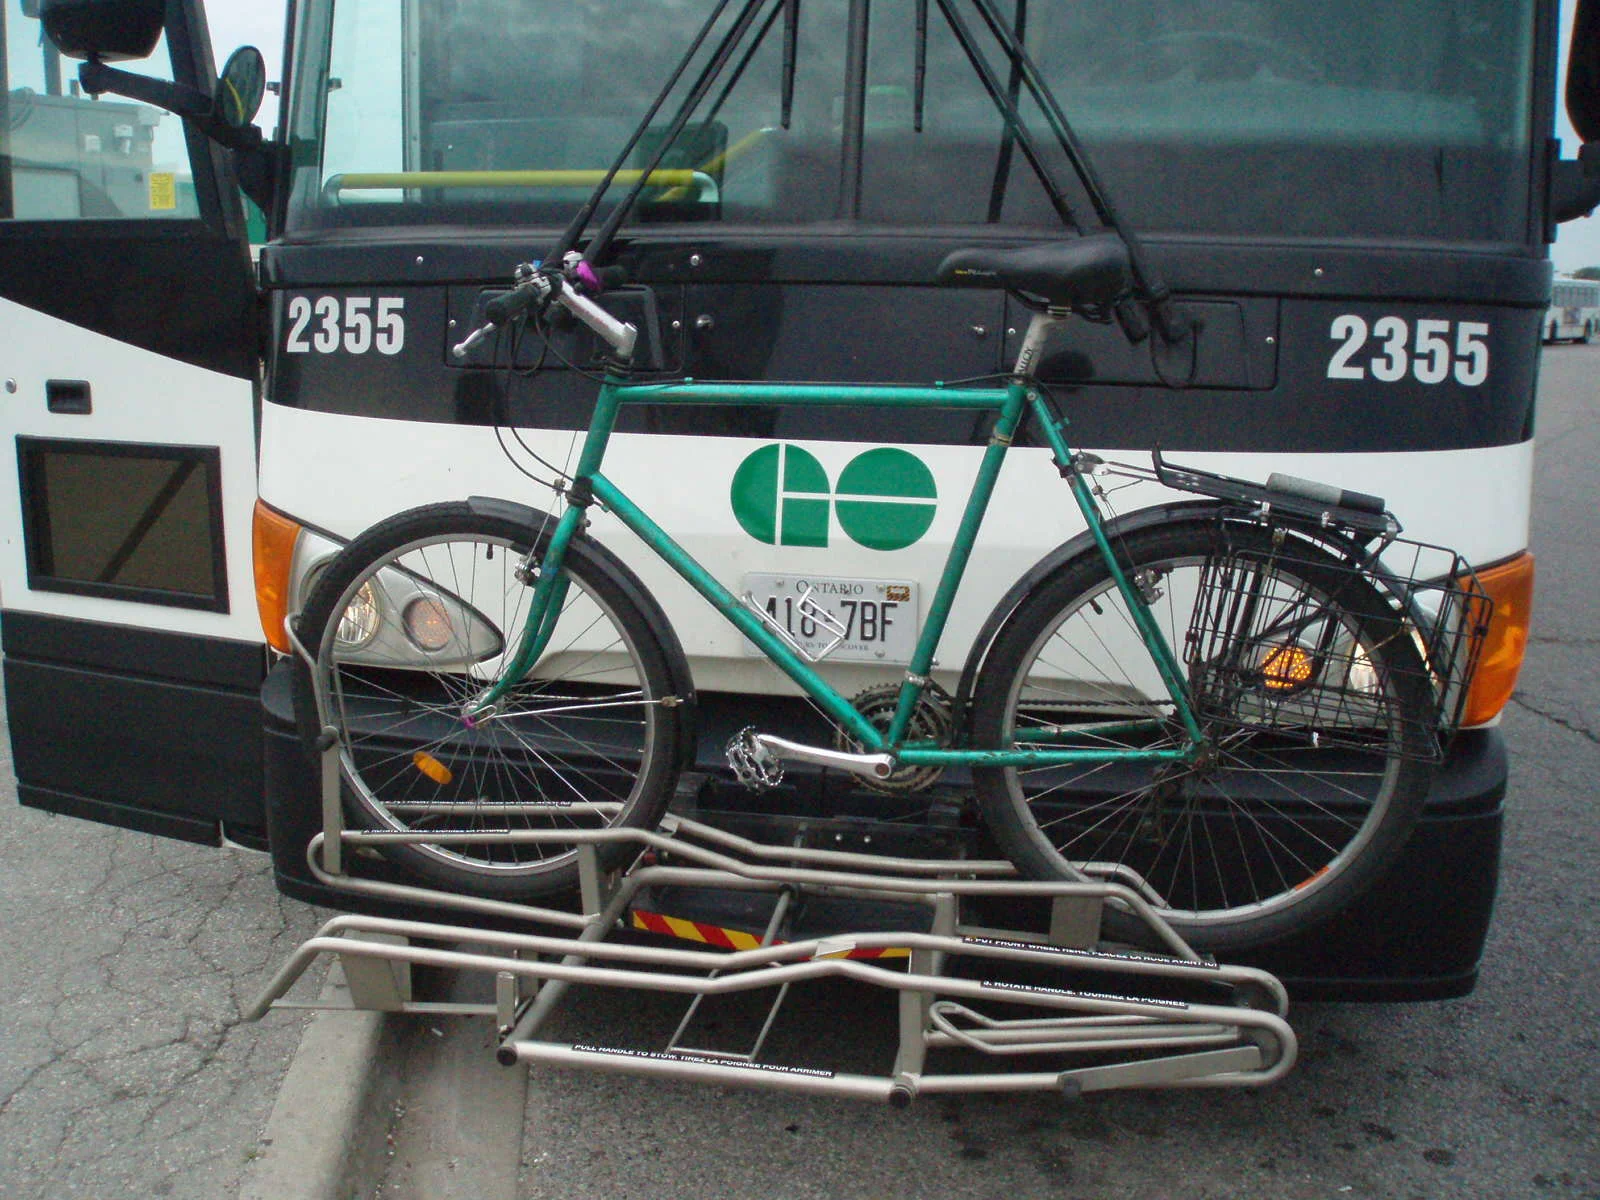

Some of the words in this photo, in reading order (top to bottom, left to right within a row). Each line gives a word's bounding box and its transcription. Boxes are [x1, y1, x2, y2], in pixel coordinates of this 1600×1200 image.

[286, 296, 404, 355] 2355
[1327, 314, 1488, 386] 2355
[840, 599, 898, 642] 7BF
[574, 1043, 597, 1051] PULL
[598, 1046, 634, 1056] HANDLE
